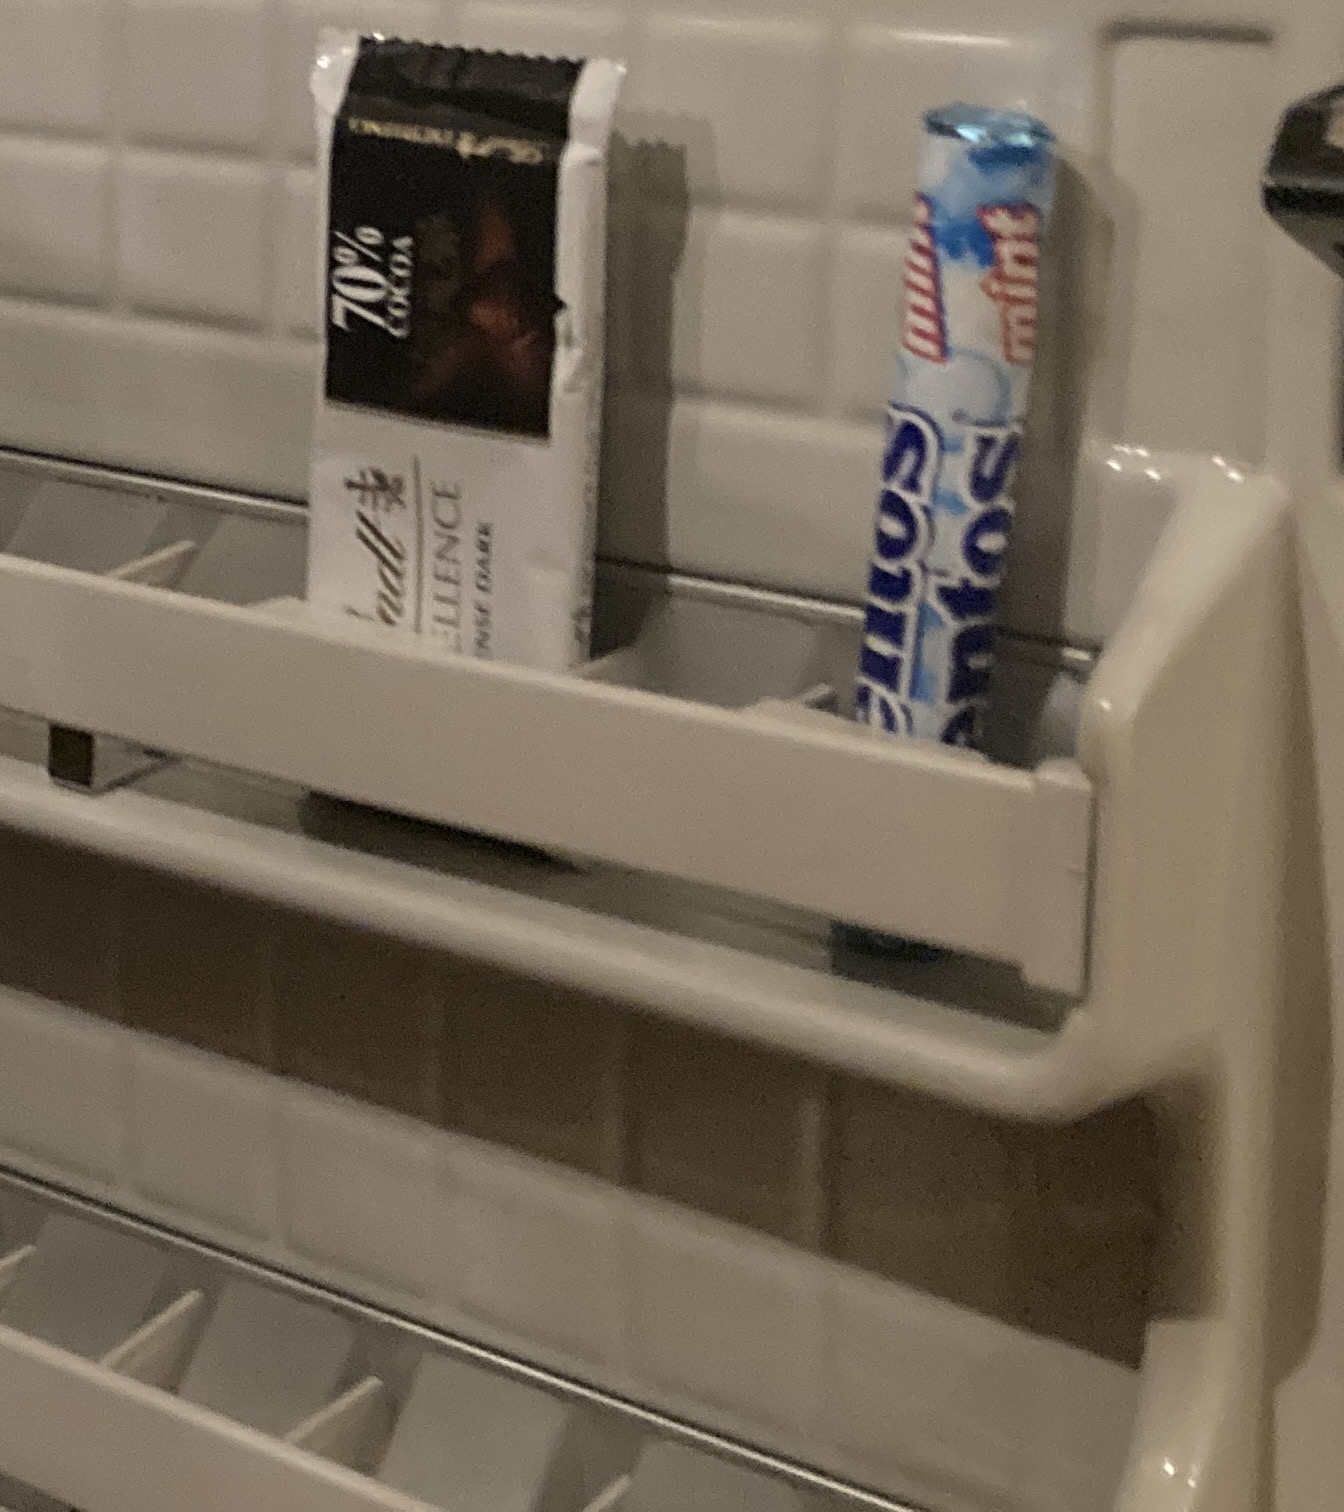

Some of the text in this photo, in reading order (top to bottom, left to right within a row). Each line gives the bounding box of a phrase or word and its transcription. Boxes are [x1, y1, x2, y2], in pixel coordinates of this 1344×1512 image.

[330, 223, 392, 334] 70%
[385, 234, 416, 340] COCOA
[976, 204, 1040, 365] mint
[474, 518, 494, 595] DARK
[936, 426, 1022, 748] entos
